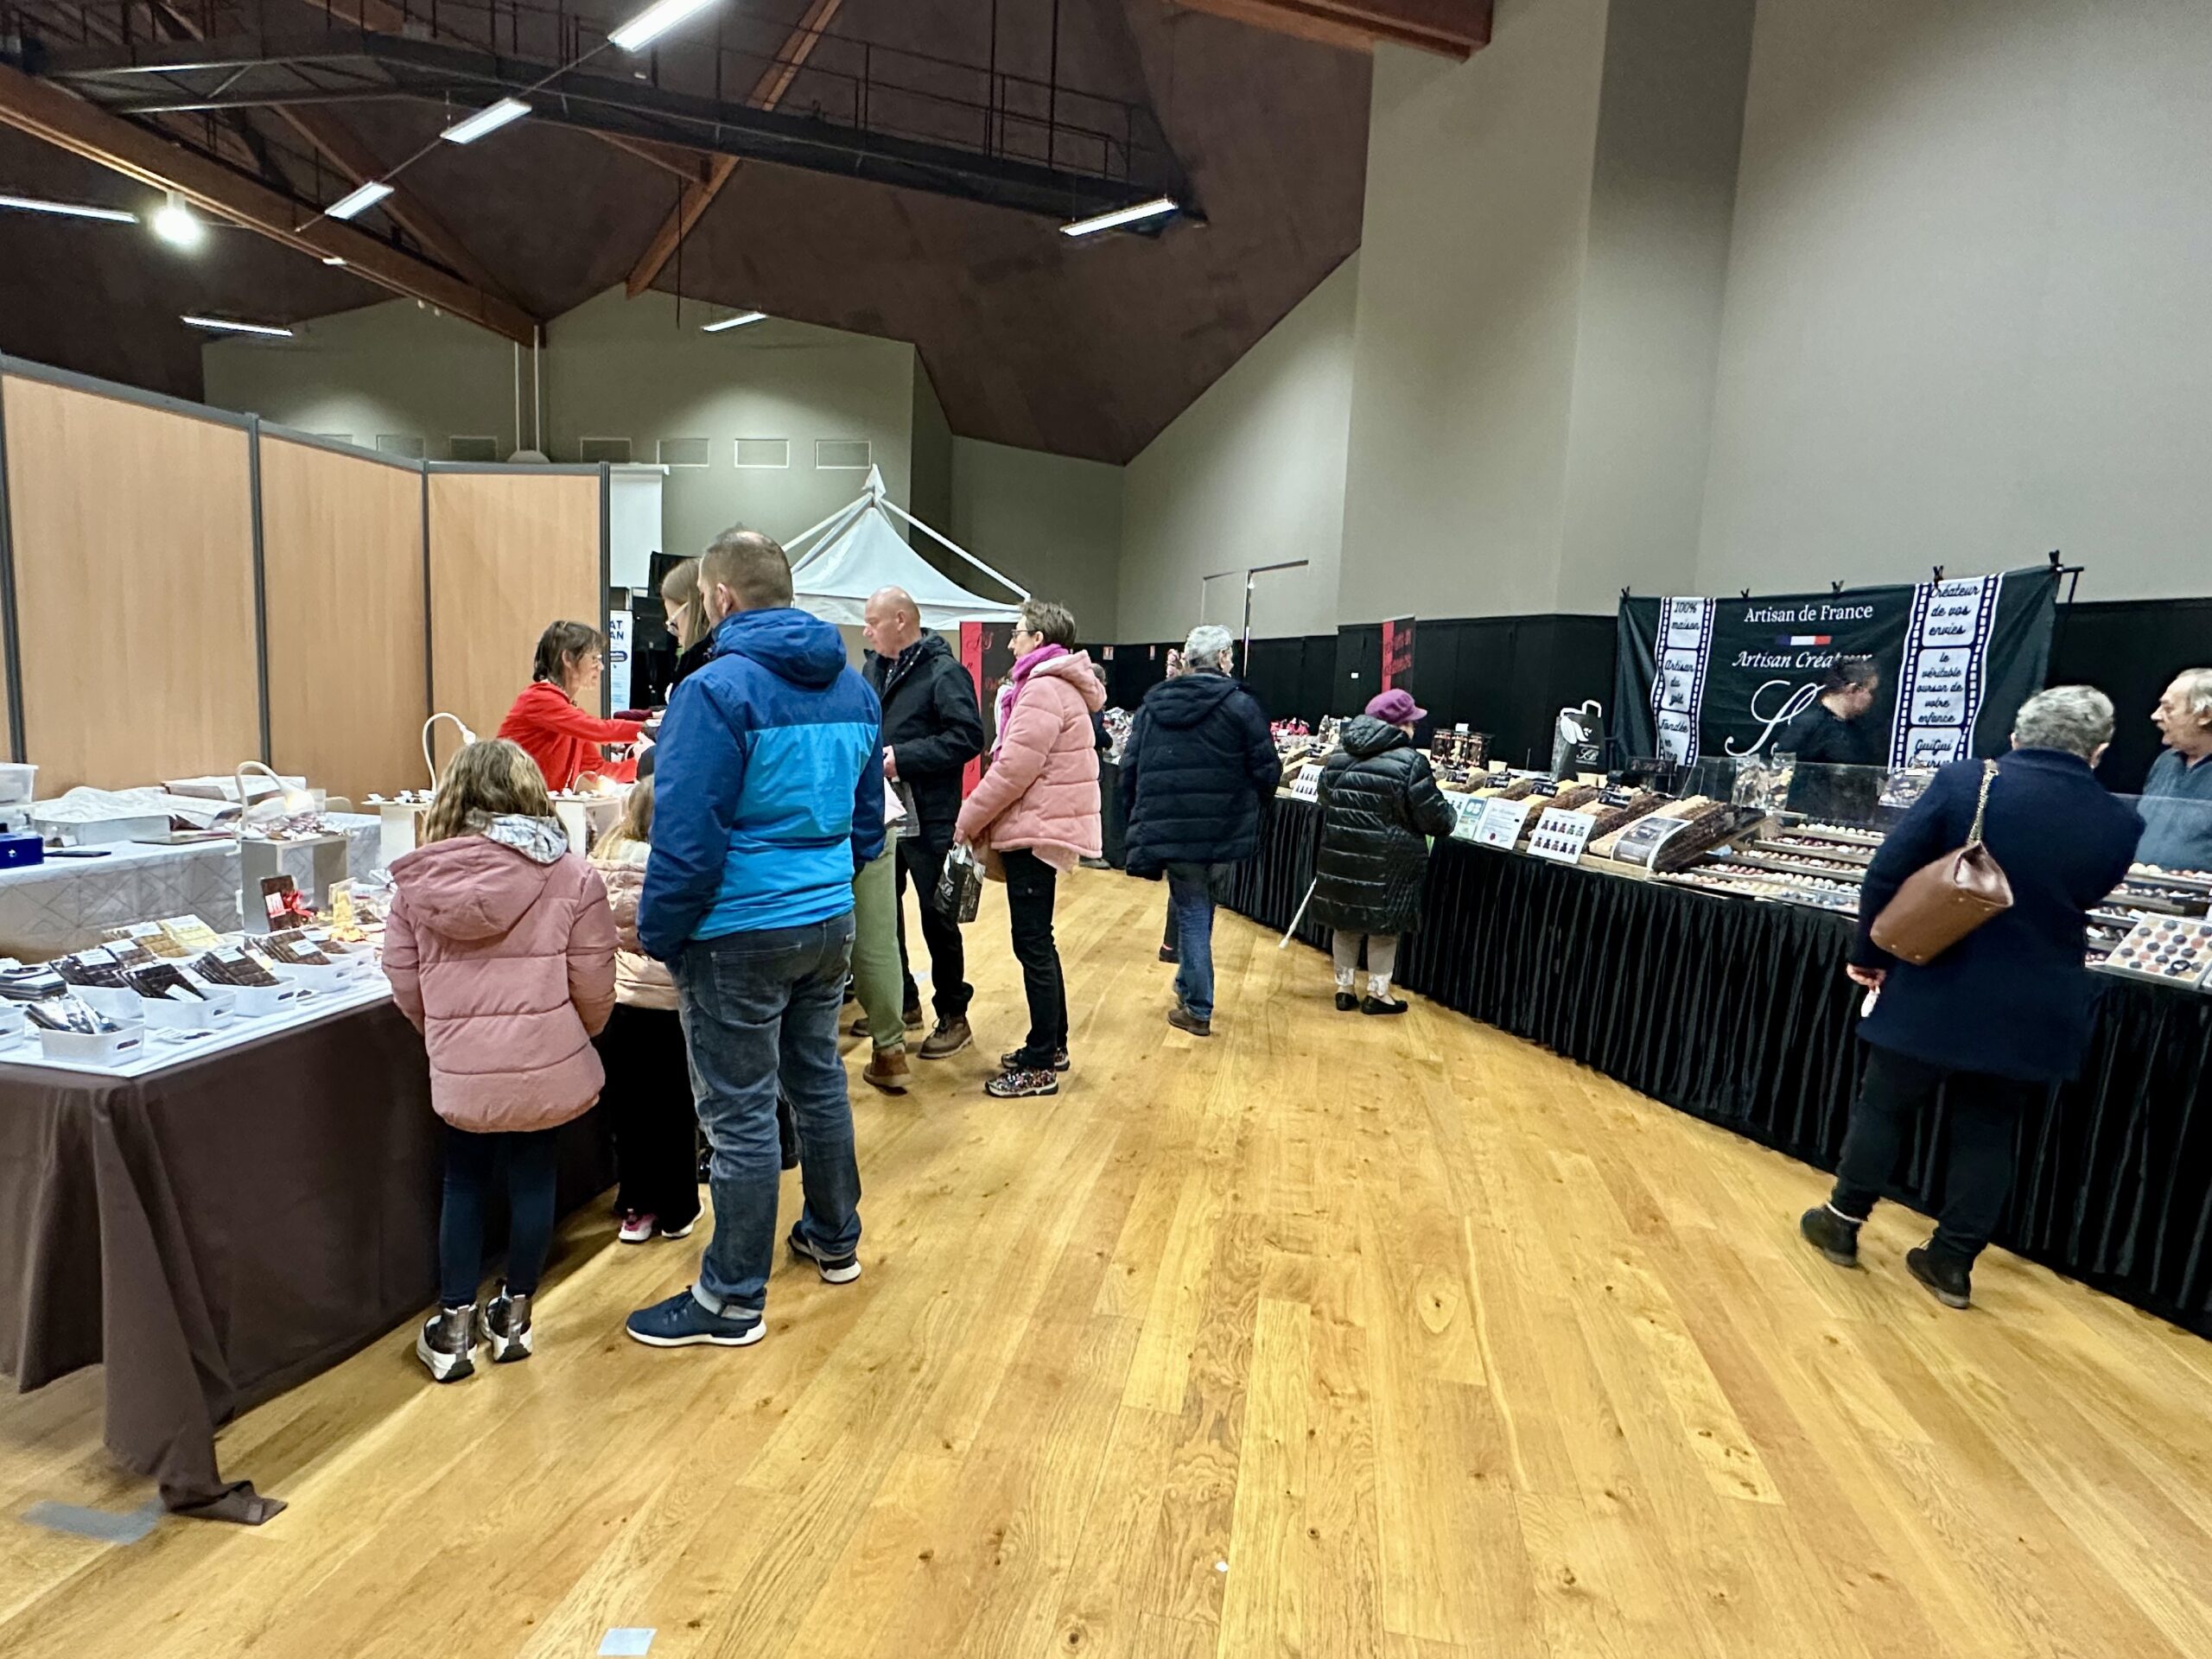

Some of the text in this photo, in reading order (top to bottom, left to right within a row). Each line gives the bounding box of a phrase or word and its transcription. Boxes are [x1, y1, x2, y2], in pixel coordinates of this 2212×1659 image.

[1674, 601, 1698, 613] 100%
[1744, 605, 1873, 622] Artisan de France
[1930, 605, 1971, 617] de vos
[1929, 623, 1966, 636] envies
[1732, 651, 1791, 669] Artisan
[1950, 682, 1963, 693] de
[1918, 712, 1955, 726] enfance
